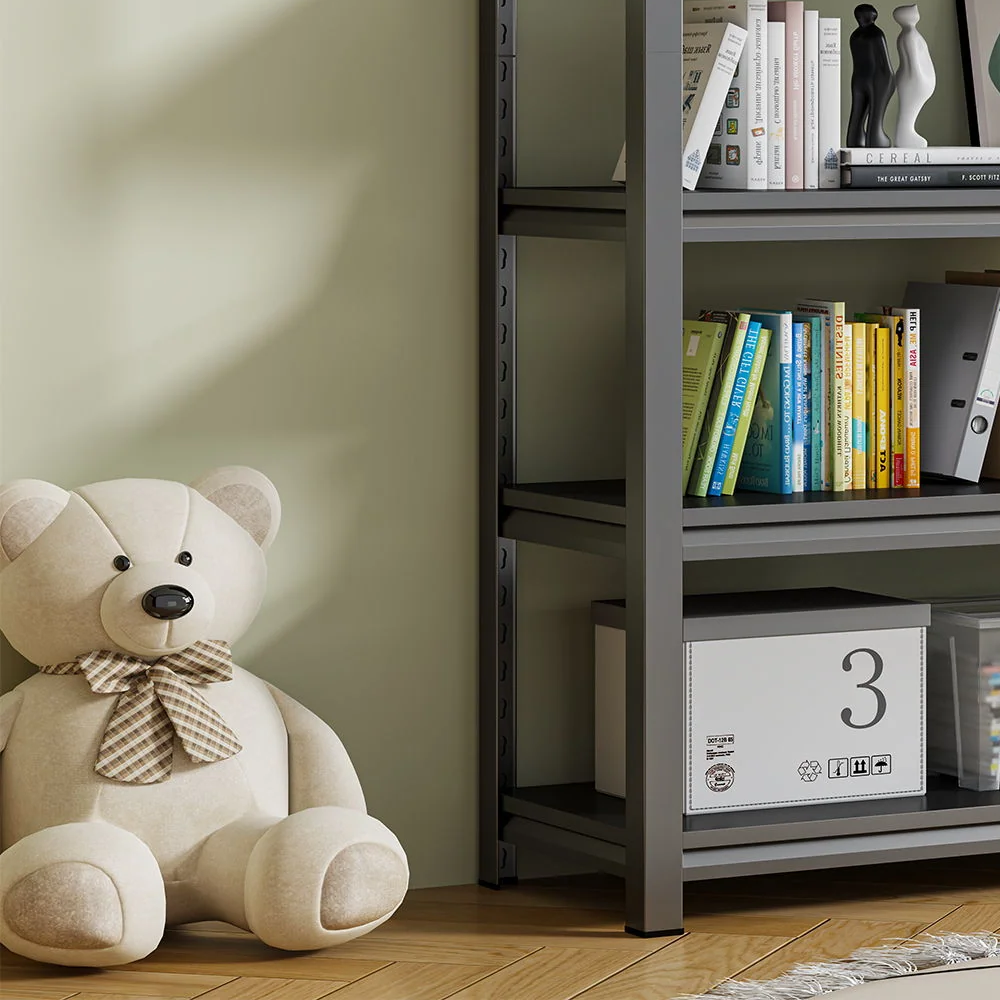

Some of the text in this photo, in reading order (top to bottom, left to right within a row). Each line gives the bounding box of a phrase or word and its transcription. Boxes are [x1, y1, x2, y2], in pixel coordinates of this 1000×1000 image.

[865, 152, 933, 164] CEREAL
[889, 175, 908, 183] GREAT
[909, 175, 931, 183] GATSBY
[839, 647, 887, 729] 3
